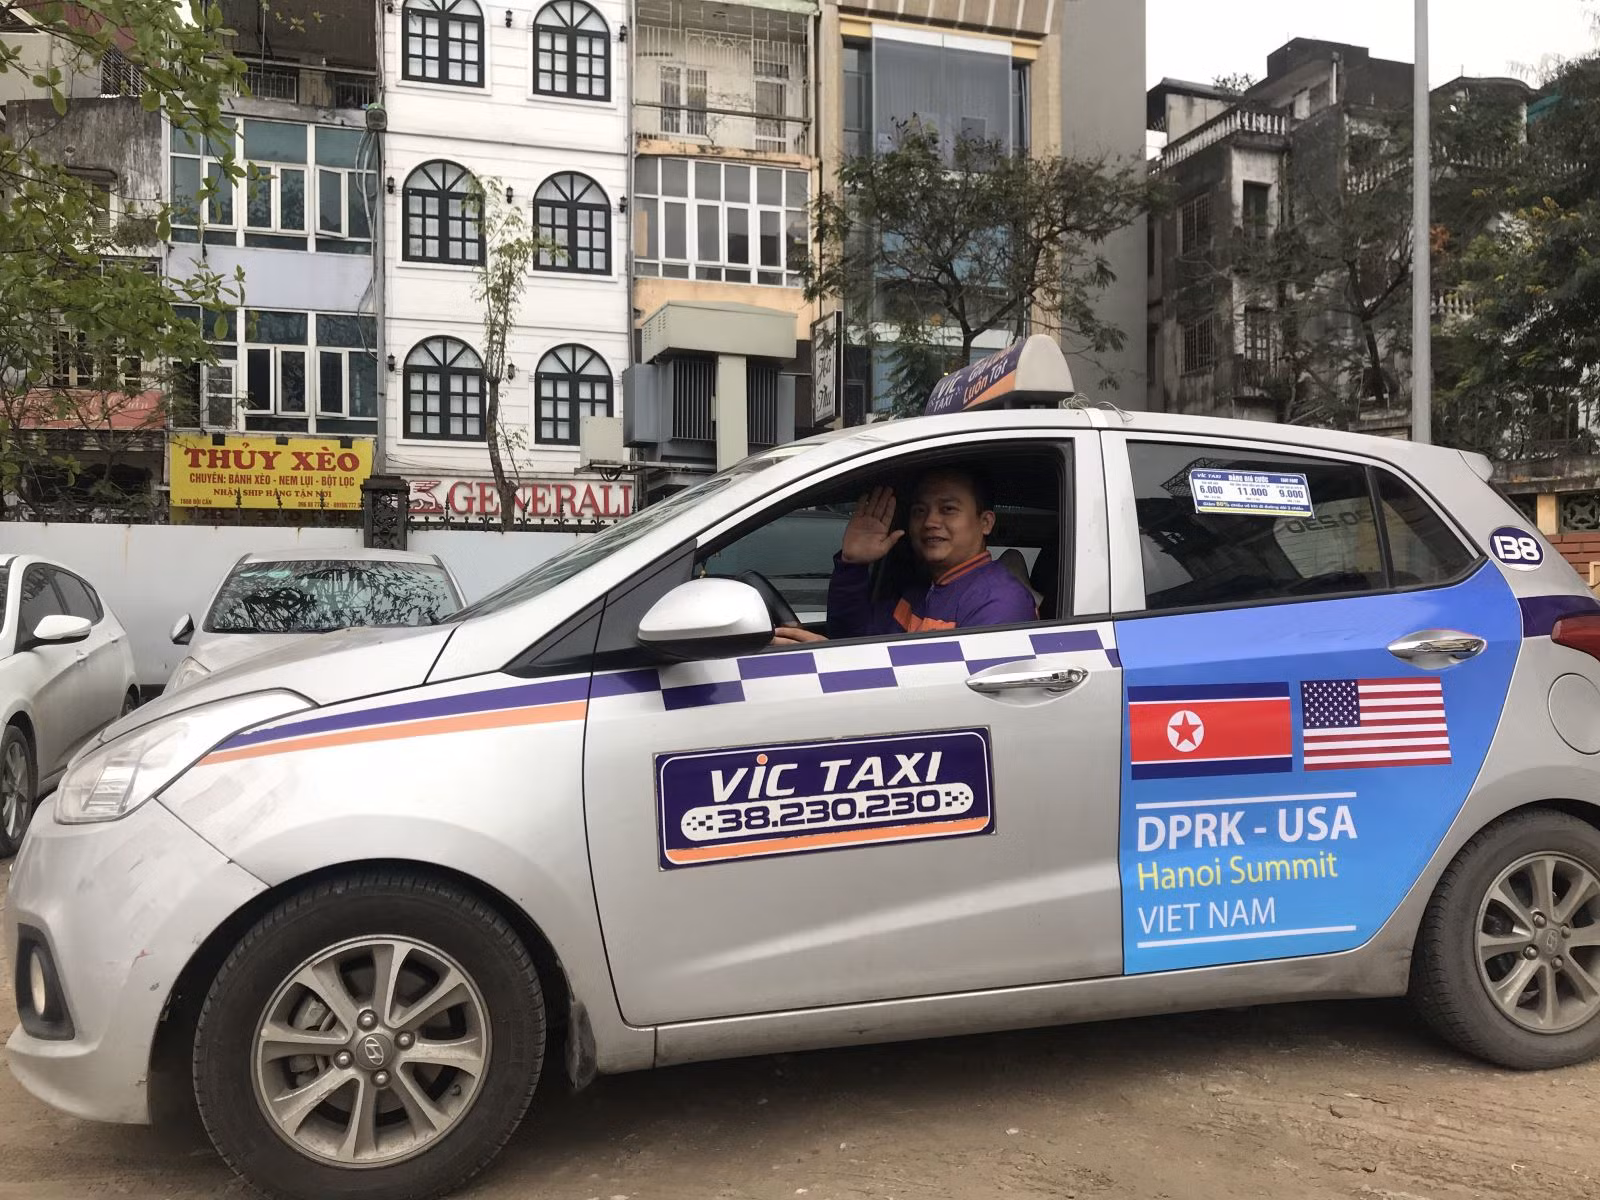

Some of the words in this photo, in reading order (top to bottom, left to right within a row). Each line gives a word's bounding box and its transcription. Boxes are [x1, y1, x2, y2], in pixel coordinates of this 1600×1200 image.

[933, 394, 955, 412] TAXI
[184, 442, 281, 471] THỦY
[291, 446, 360, 473] XÈO
[243, 488, 263, 497] SHIP
[279, 475, 298, 486] NEM
[300, 475, 313, 488] LỤI
[1200, 485, 1223, 495] 6.000
[1237, 487, 1268, 497] 11.000
[1279, 489, 1304, 499] 9.000
[449, 480, 633, 518] GENERALI
[1493, 535, 1541, 561] 138
[820, 751, 942, 792] TAXI
[717, 789, 941, 834] 38.230.230
[1137, 811, 1246, 852] DPRK
[1278, 805, 1358, 843] USA
[1137, 857, 1221, 891] Hanoi
[1230, 851, 1339, 885] Summit
[1138, 903, 1201, 935] VIET
[1209, 897, 1276, 930] NAM
